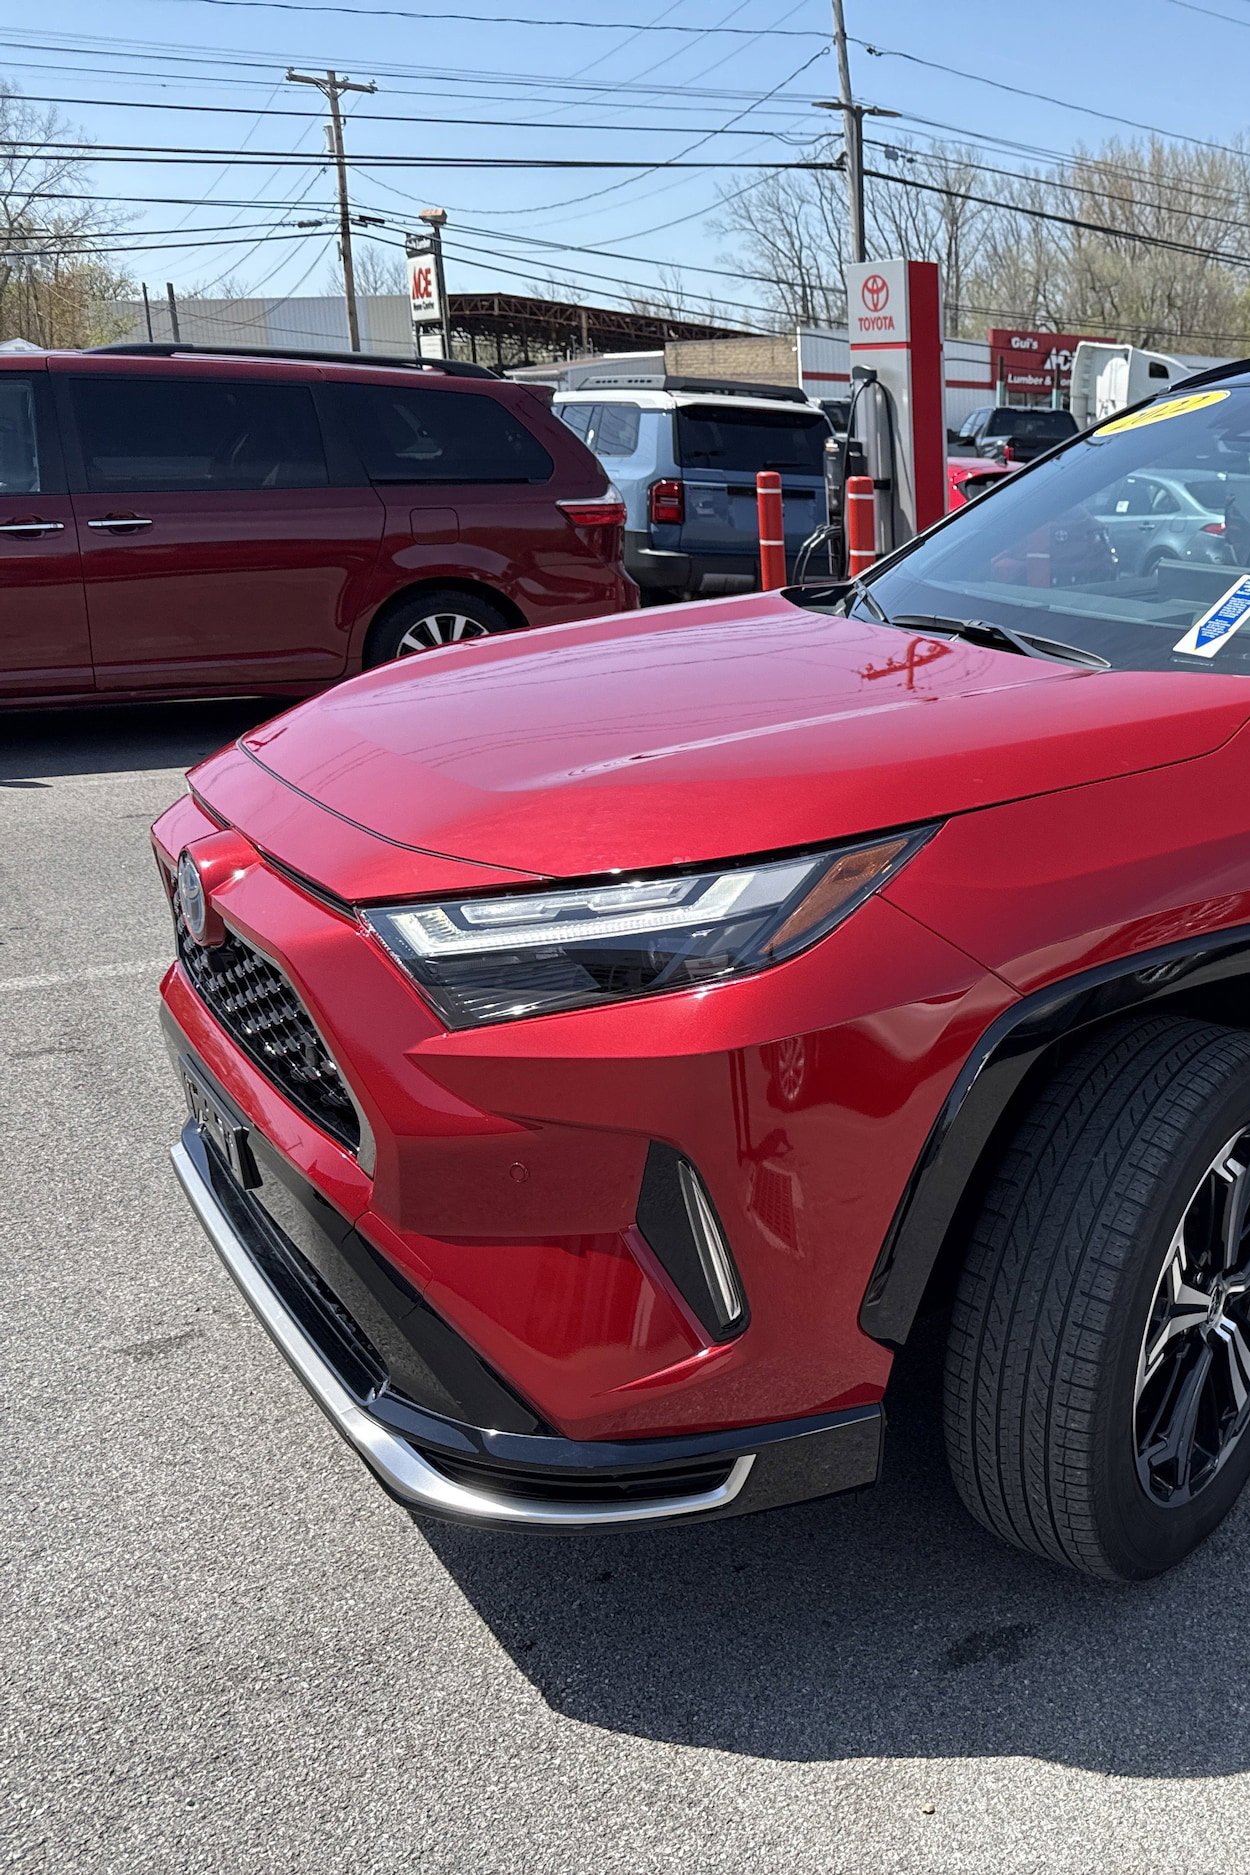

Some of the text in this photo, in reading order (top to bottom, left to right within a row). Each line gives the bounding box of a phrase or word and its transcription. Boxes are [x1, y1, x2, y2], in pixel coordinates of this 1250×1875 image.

[412, 267, 432, 301] ACE
[858, 316, 895, 331] TOYOTA
[1011, 337, 1038, 350] Gui's
[1043, 347, 1077, 371] AC
[1007, 373, 1043, 385] Lumber
[1044, 375, 1052, 385] &
